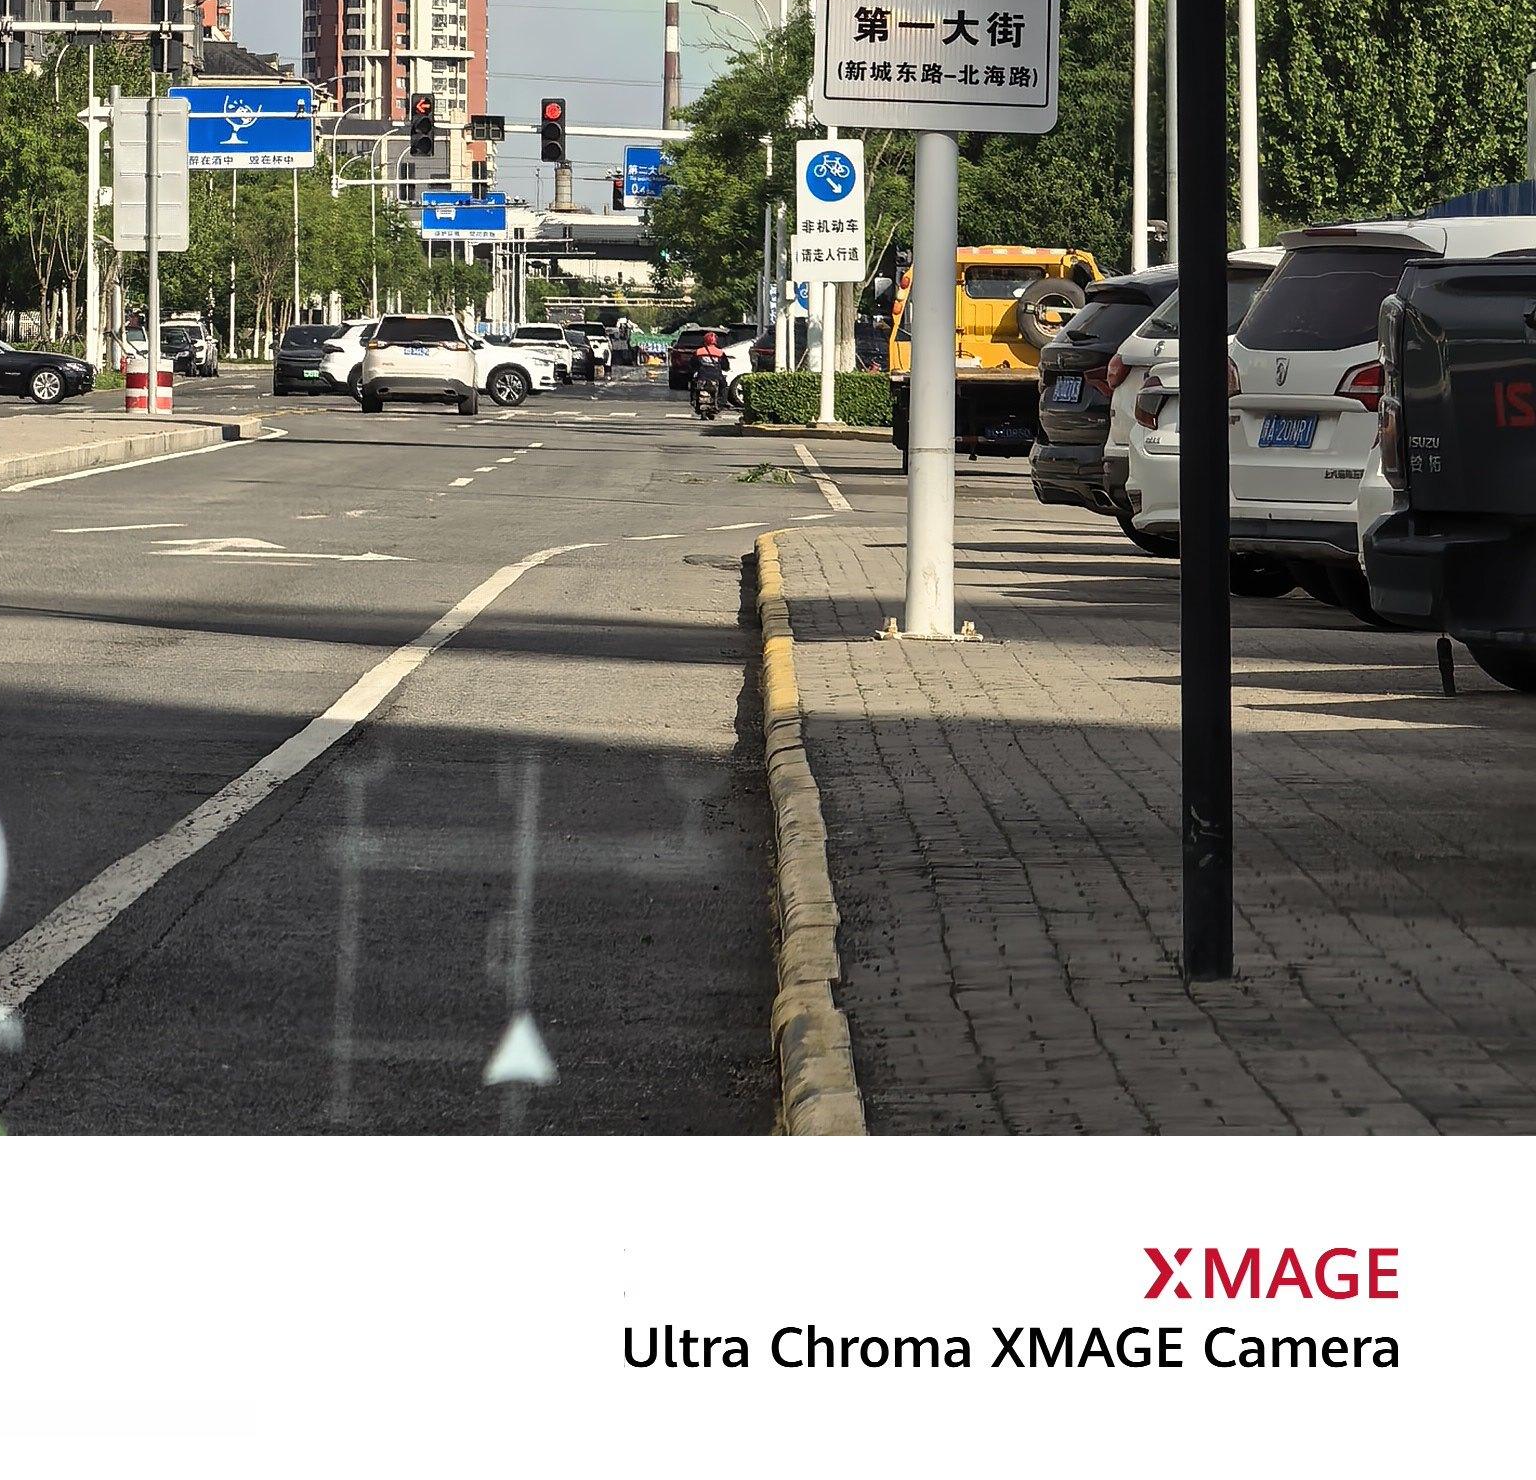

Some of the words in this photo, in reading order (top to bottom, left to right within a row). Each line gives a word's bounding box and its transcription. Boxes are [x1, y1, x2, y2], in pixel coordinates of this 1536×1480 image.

[853, 6, 1026, 49] 第一大街
[801, 218, 859, 235] 非机动车
[801, 247, 860, 263] 请走人行道
[1409, 436, 1440, 449] ISUZU
